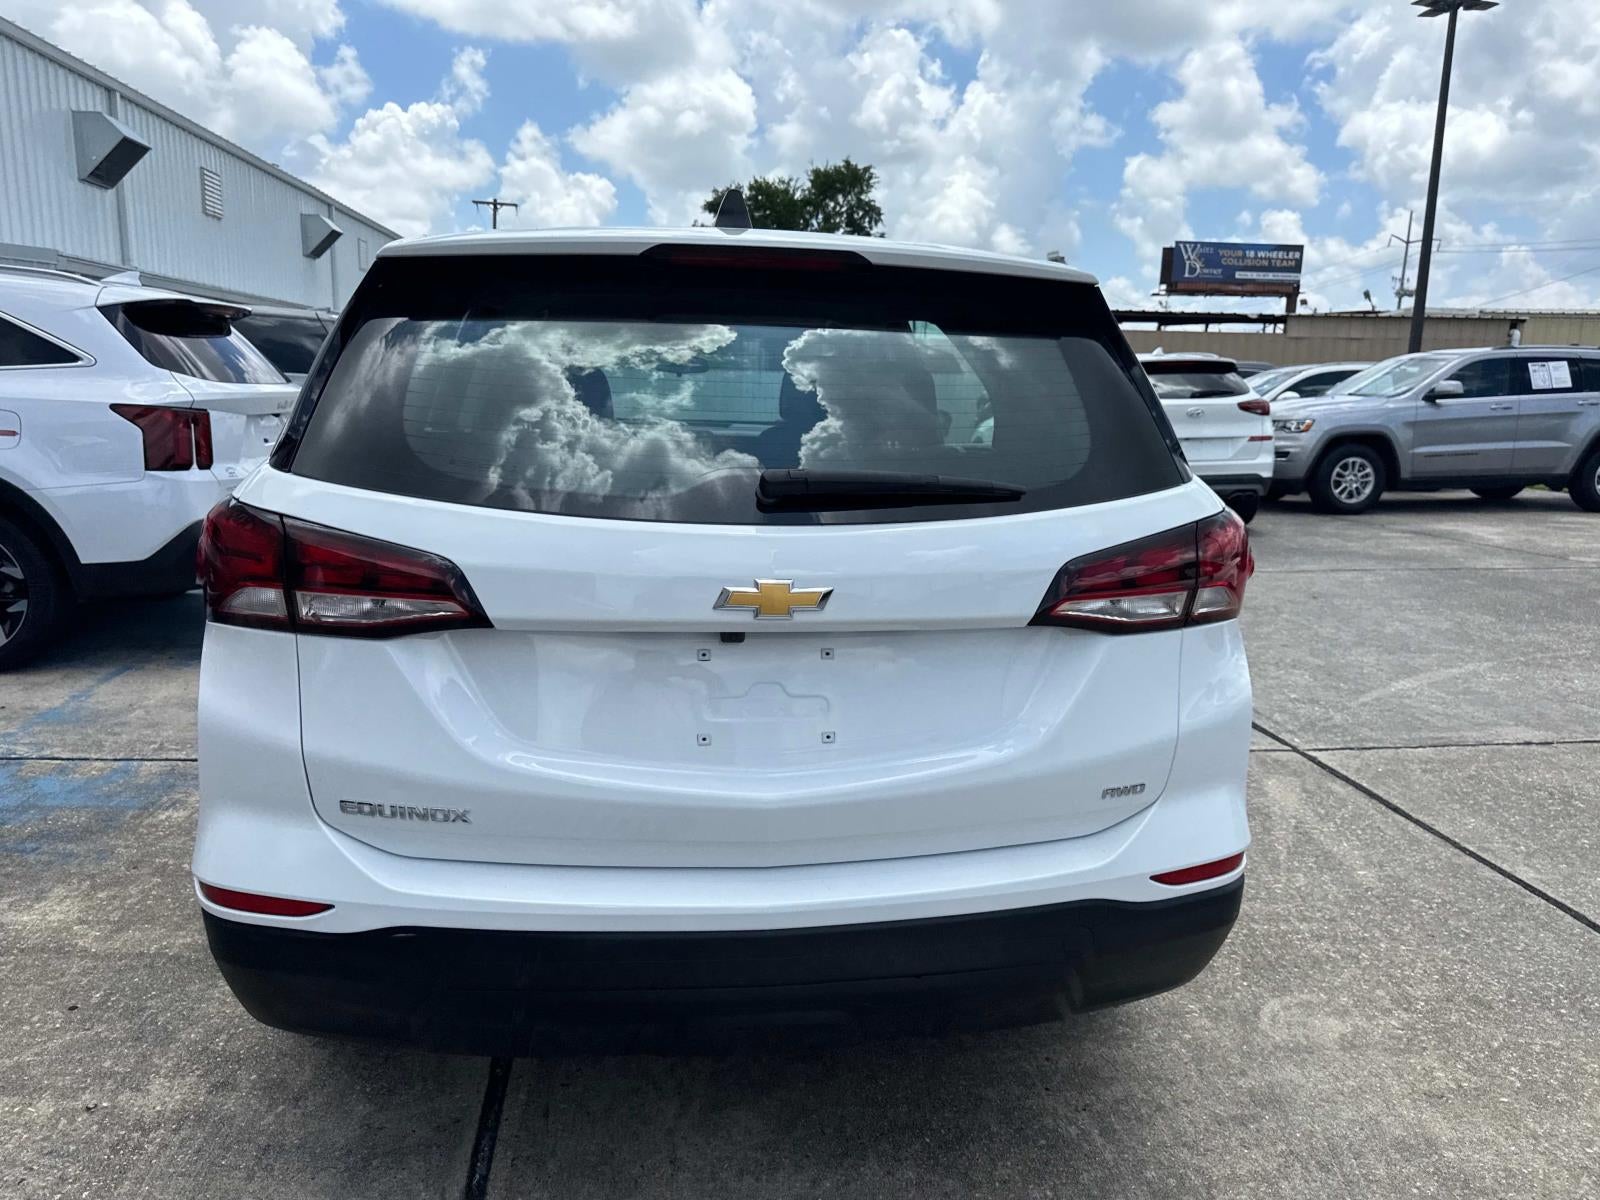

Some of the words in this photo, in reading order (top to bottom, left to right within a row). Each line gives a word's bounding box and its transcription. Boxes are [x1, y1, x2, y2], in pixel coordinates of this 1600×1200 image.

[1218, 249, 1243, 258] YOUR
[1245, 250, 1255, 258] 18
[1257, 250, 1301, 260] WHEELER
[1221, 258, 1269, 267] COLLISION
[1271, 259, 1296, 268] TEAM
[339, 799, 472, 824] EQUINOX
